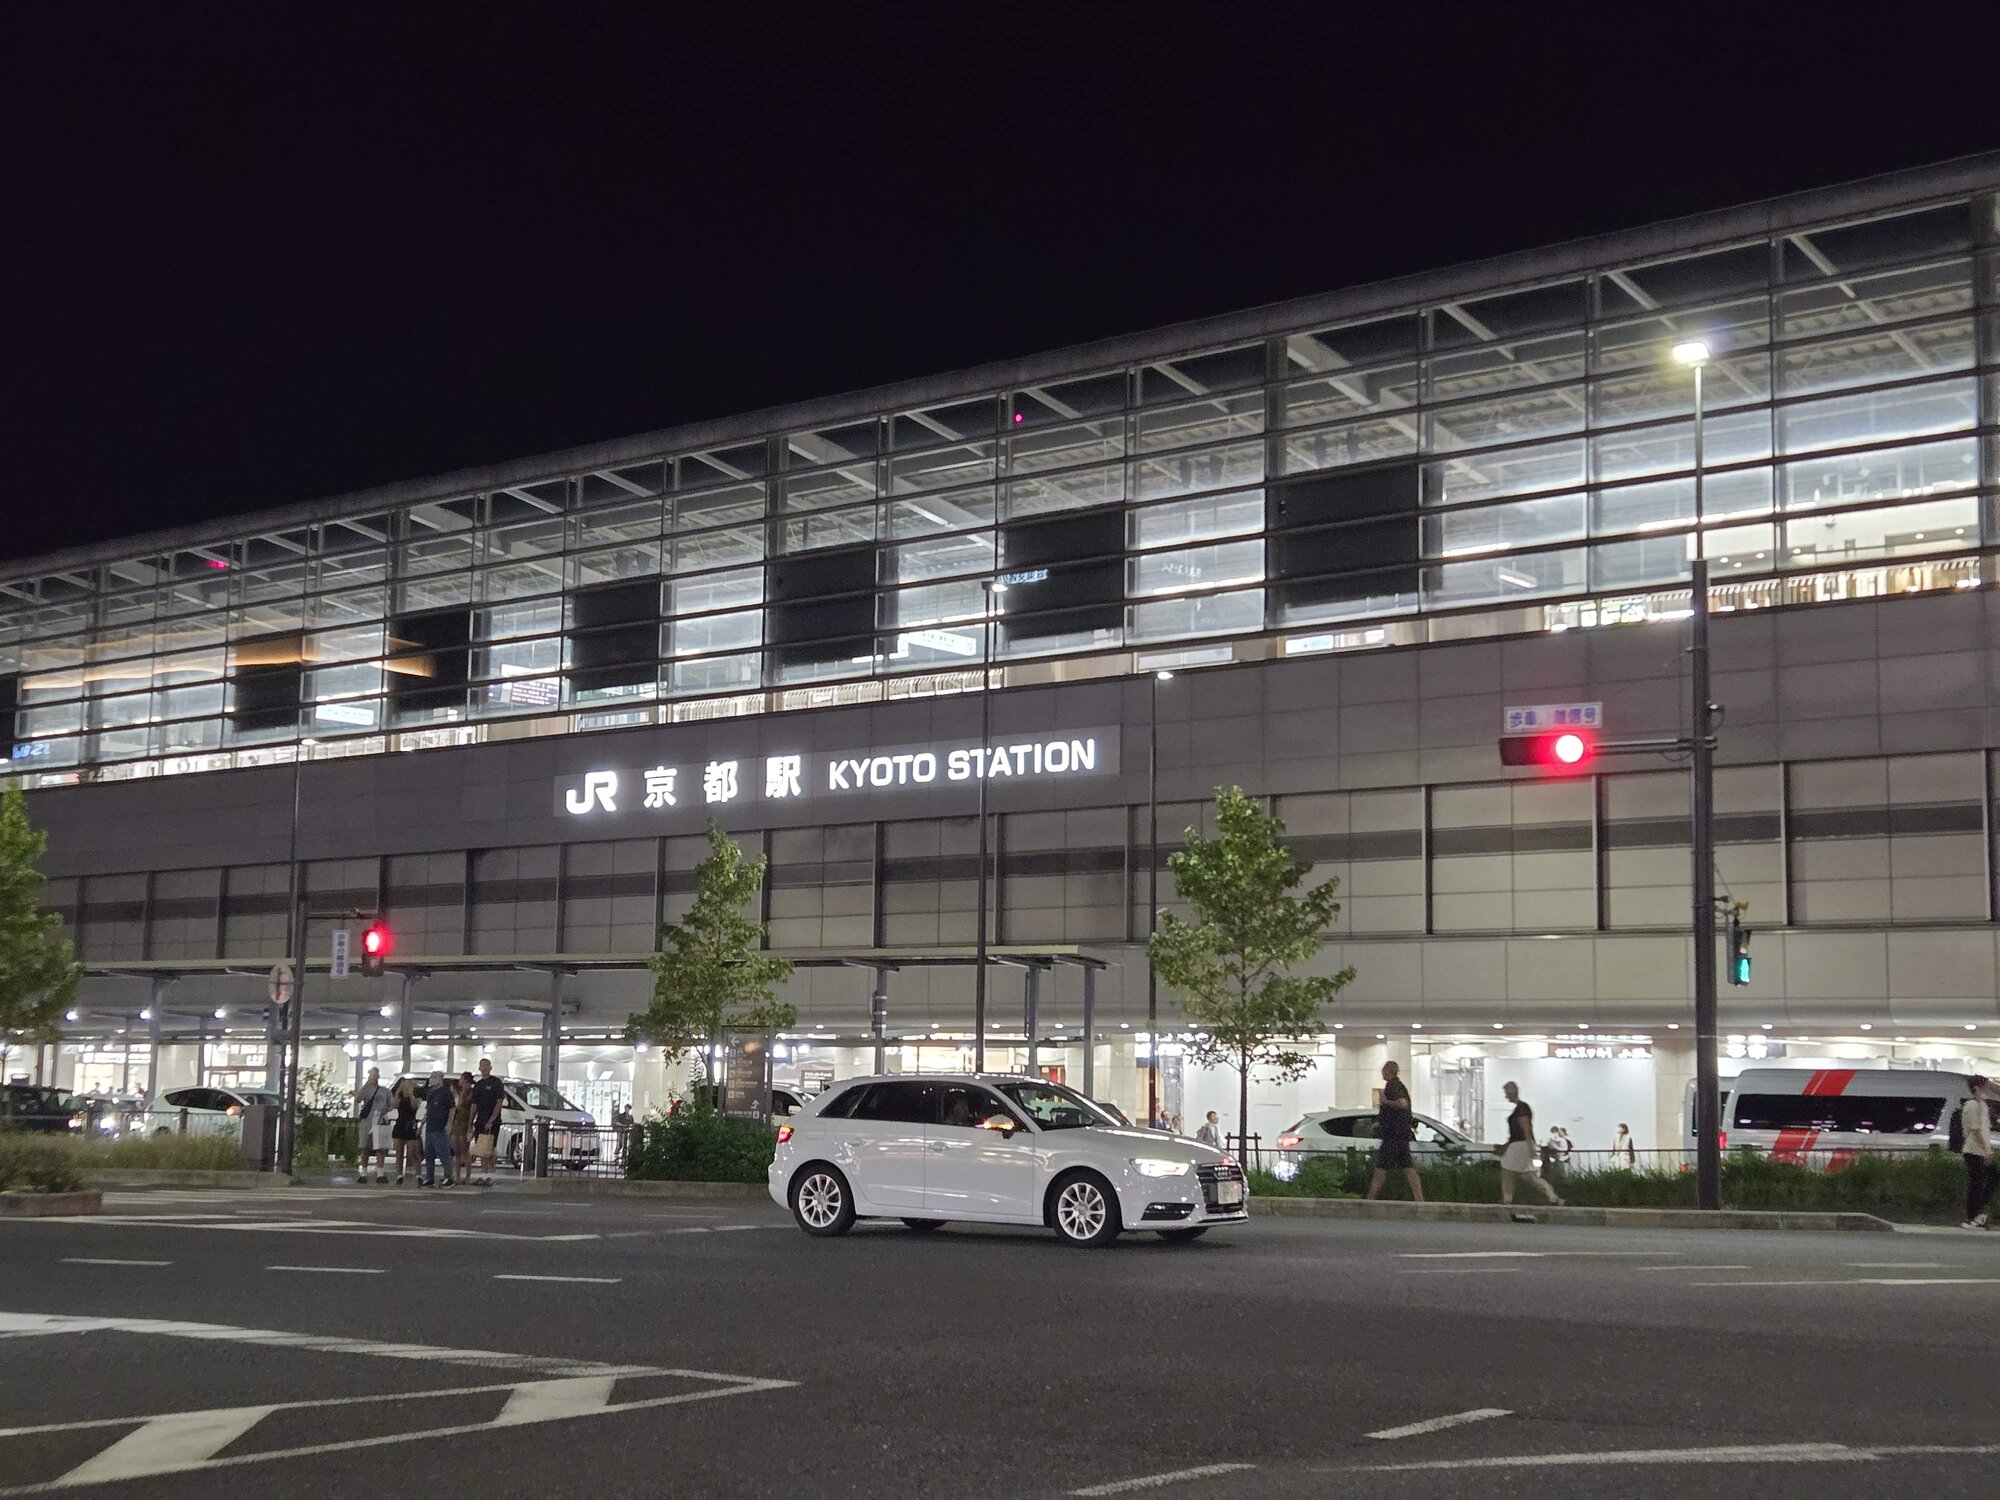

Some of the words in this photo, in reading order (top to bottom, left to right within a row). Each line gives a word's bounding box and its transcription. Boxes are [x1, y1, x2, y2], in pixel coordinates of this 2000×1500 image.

[566, 770, 620, 815] JR
[643, 755, 802, 808] 京都駅
[829, 753, 938, 791] KYOTO
[947, 739, 1096, 781] STATION
